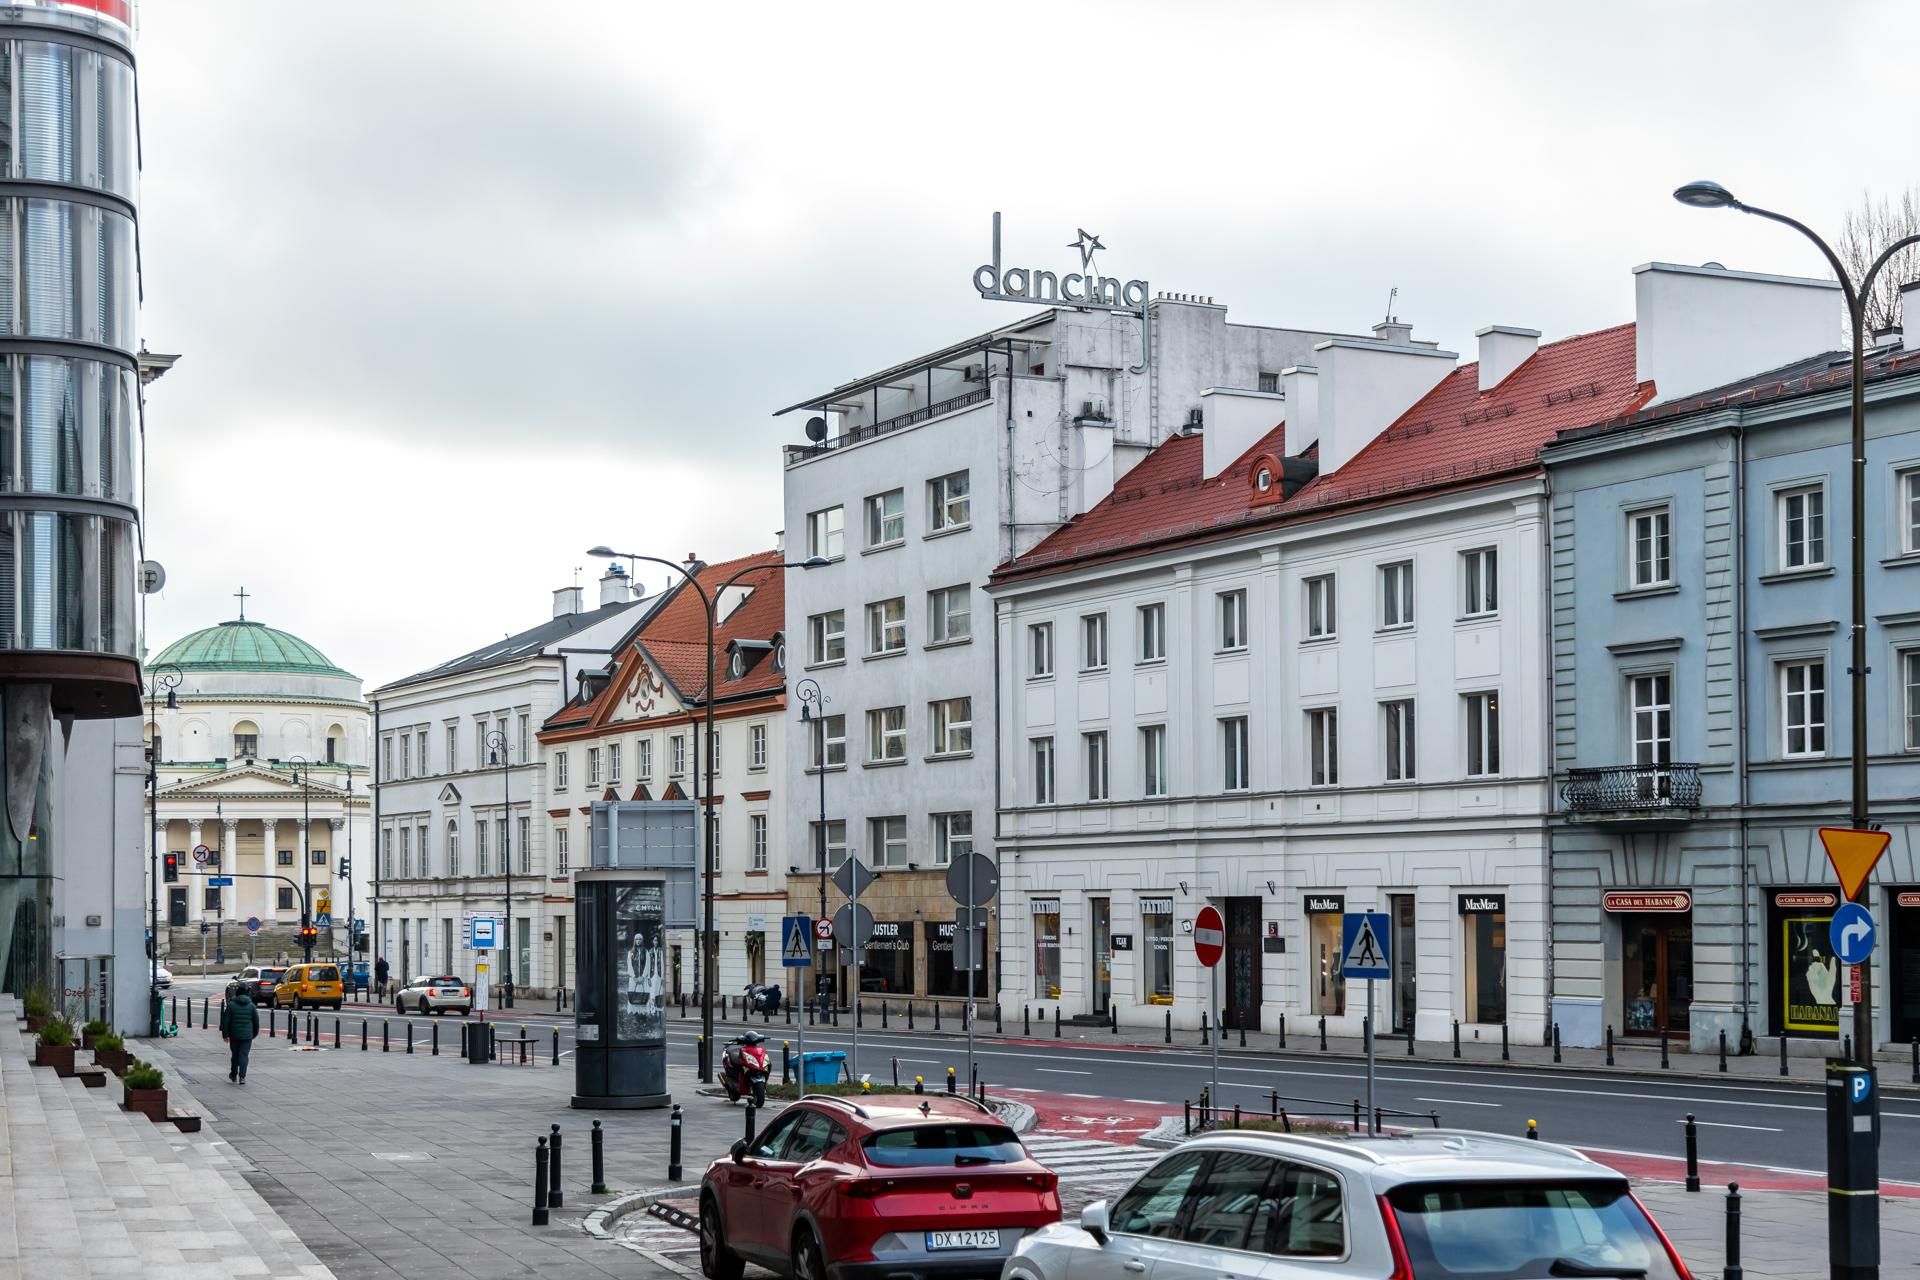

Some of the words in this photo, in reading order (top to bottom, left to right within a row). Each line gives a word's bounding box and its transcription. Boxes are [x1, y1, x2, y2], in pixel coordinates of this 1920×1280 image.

[1031, 901, 1060, 914] TATTOO
[1140, 900, 1172, 914] TATTOO
[1310, 899, 1339, 910] MaxMara
[1465, 898, 1498, 910] MaxMara
[1616, 898, 1632, 906] CASA
[1645, 898, 1673, 906] HABANO
[896, 939, 909, 950] Club
[1854, 1077, 1866, 1098] P
[935, 1233, 952, 1247] DX
[958, 1231, 996, 1245] 12125
